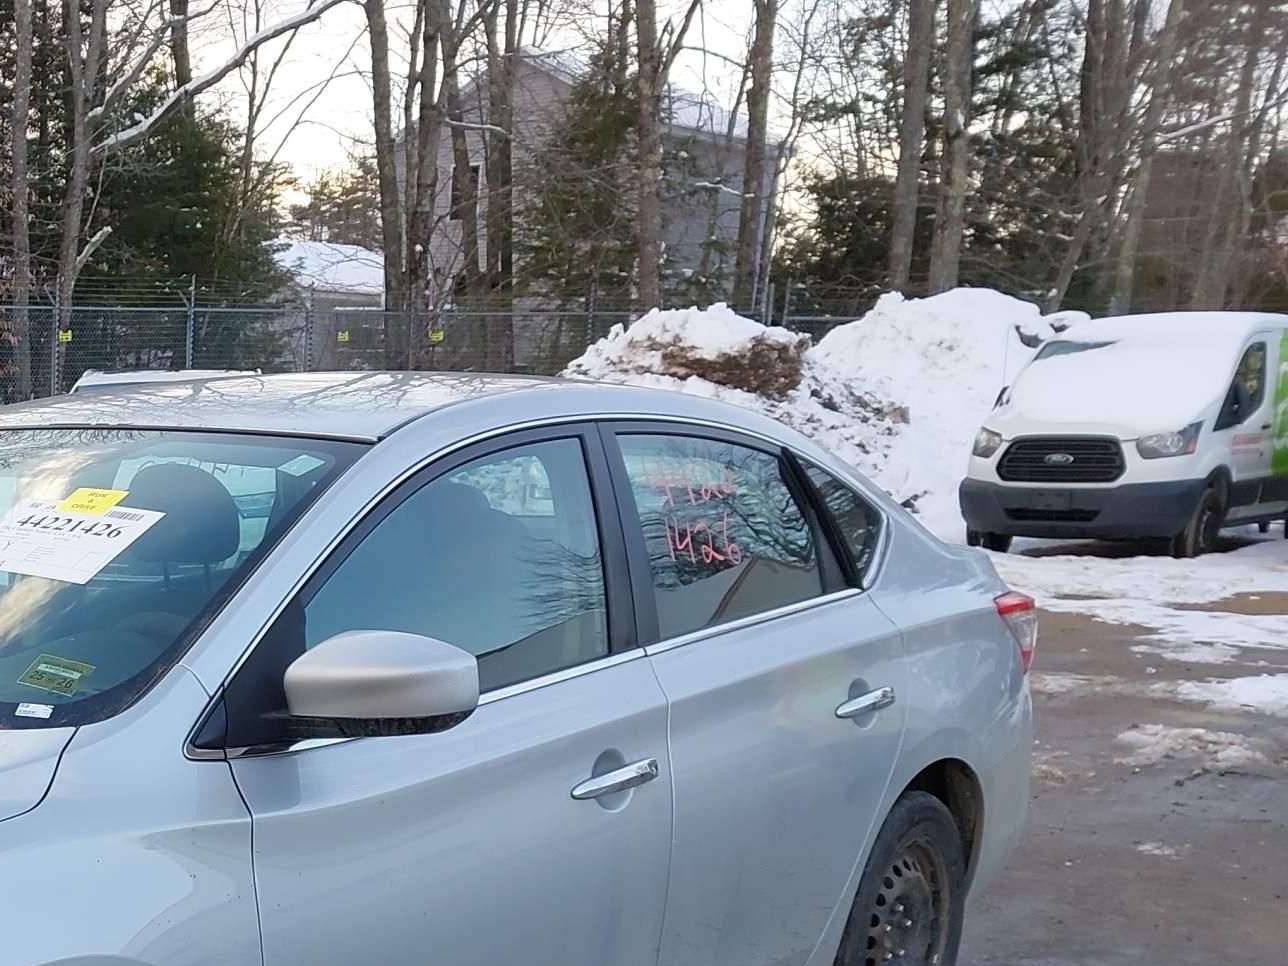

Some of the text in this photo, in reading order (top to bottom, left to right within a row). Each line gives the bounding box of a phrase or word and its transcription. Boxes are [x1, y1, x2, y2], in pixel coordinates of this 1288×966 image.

[70, 503, 98, 511] DRIVE
[17, 514, 126, 539] 44221426
[664, 511, 742, 566] 1426
[28, 670, 74, 689] 25 26
